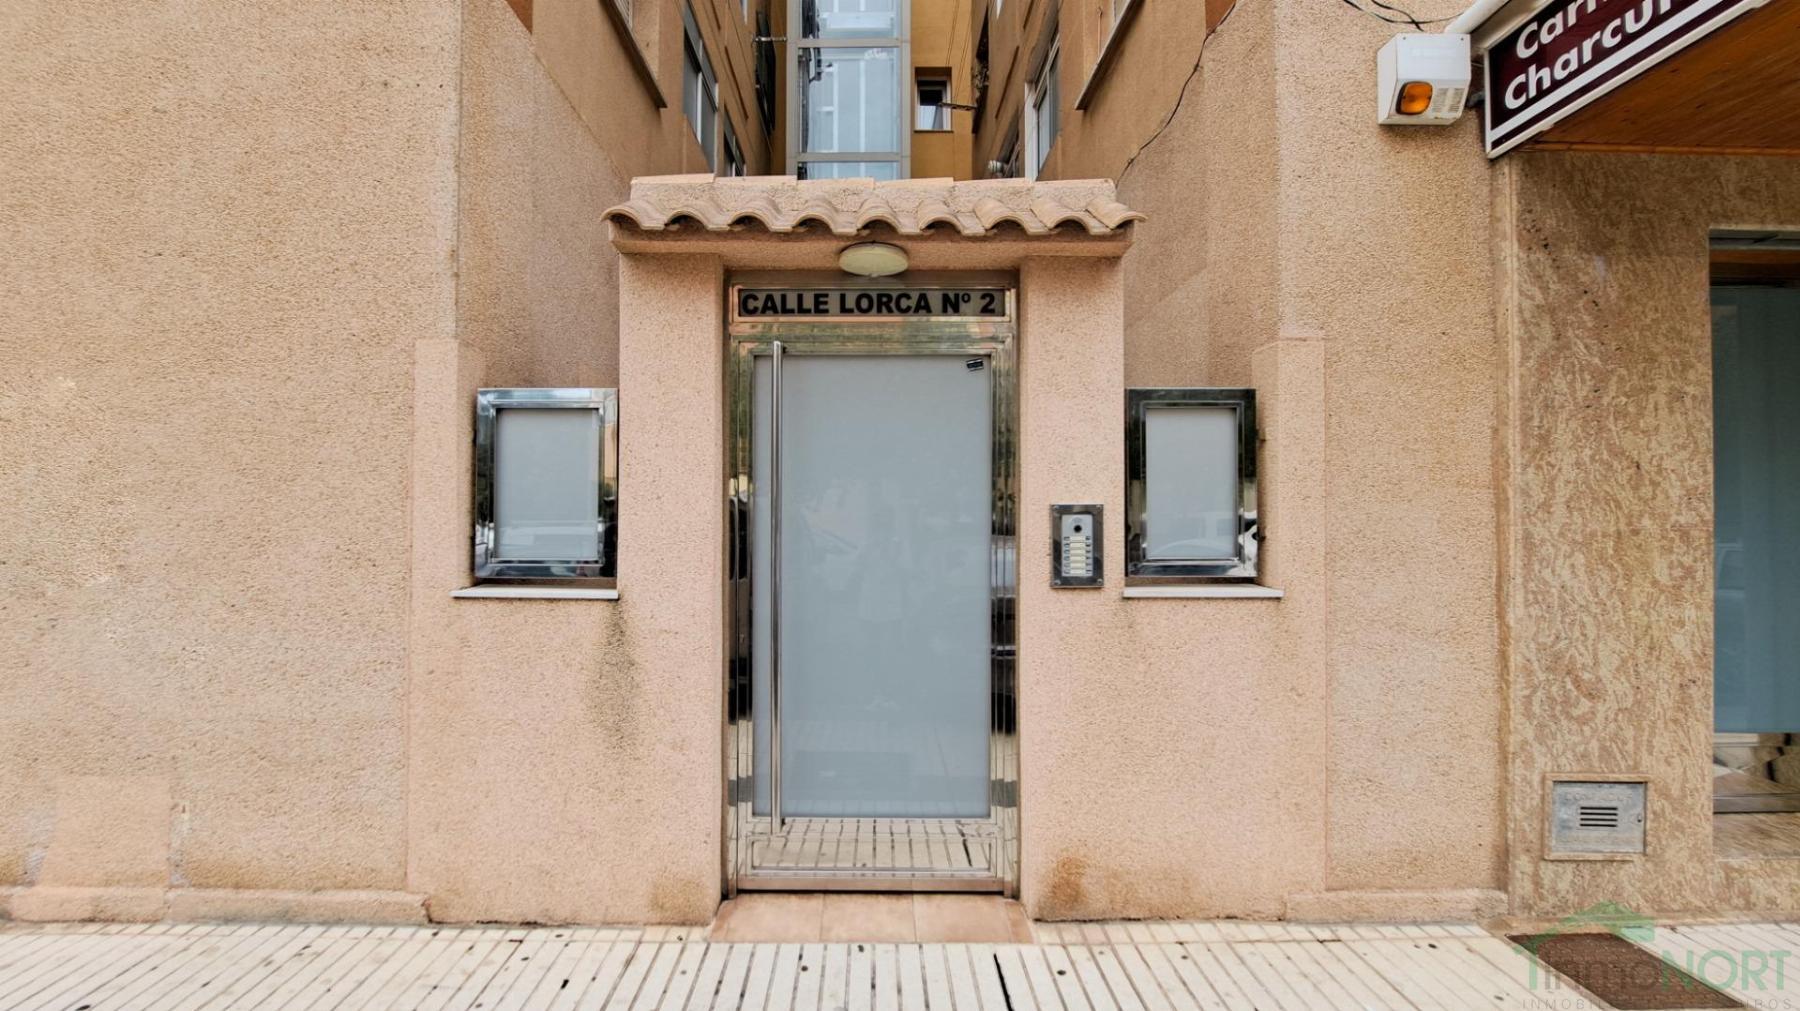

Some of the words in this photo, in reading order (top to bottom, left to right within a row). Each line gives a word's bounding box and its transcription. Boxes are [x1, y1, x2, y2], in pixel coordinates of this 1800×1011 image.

[741, 293, 829, 315] CALLE
[839, 292, 932, 315] LORCA
[980, 293, 996, 314] 2
